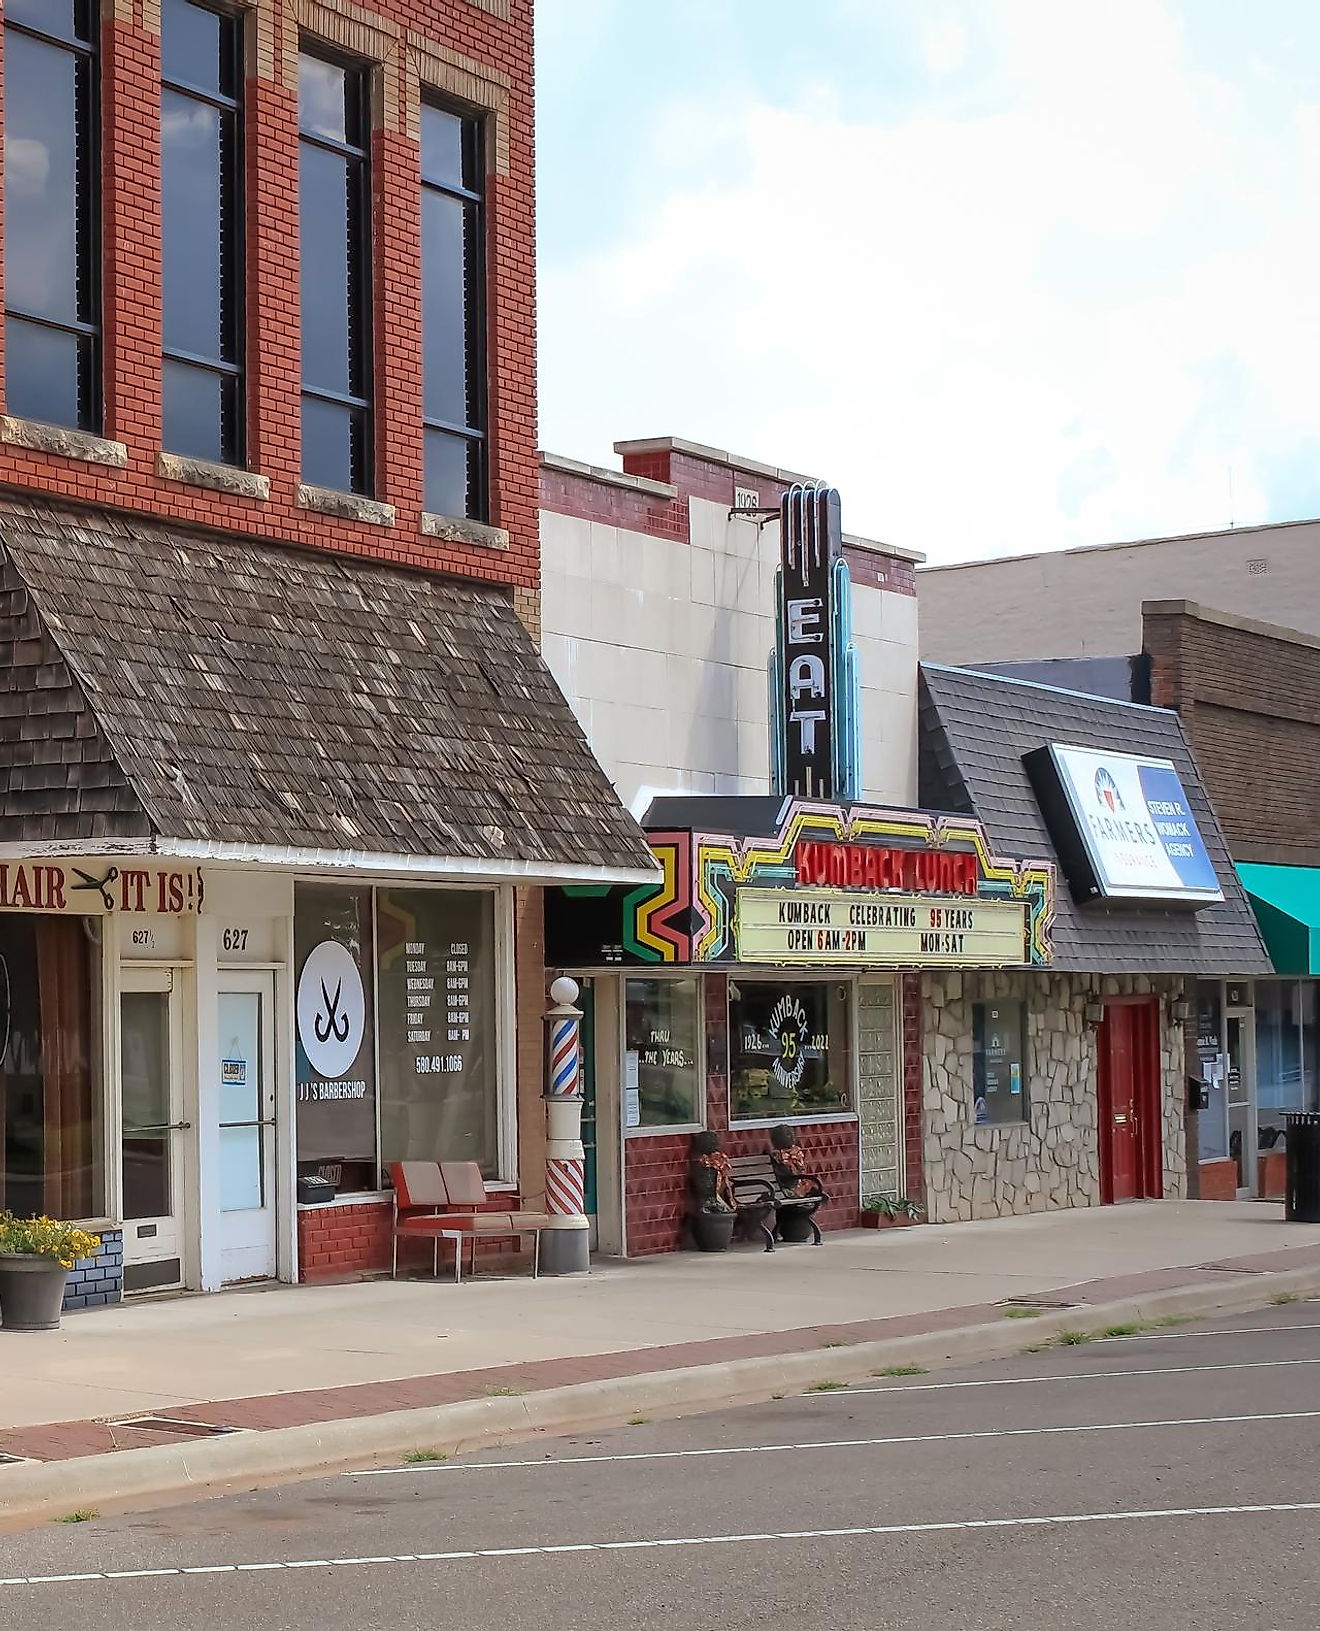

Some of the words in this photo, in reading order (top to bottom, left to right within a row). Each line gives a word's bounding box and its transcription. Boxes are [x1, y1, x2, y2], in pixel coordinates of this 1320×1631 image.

[787, 598, 826, 755] EAT
[1147, 801, 1176, 816] STEVEN
[1088, 814, 1157, 846] FARMERS
[1165, 843, 1194, 858] AGENCY
[120, 870, 151, 911] IT
[779, 902, 831, 924] KUMBACK
[849, 904, 916, 926] CELEBRATING
[930, 908, 942, 928] 95
[944, 909, 973, 929] YEARS
[223, 929, 248, 950] 627
[787, 929, 813, 949] OPEN
[817, 930, 866, 950] 6AM-2PM
[920, 933, 964, 953] MON-SAT
[768, 995, 808, 1041] KUMBACK
[650, 1030, 670, 1043] THRU
[781, 1032, 796, 1058] 95
[319, 1080, 366, 1100] BARBERSHOP
